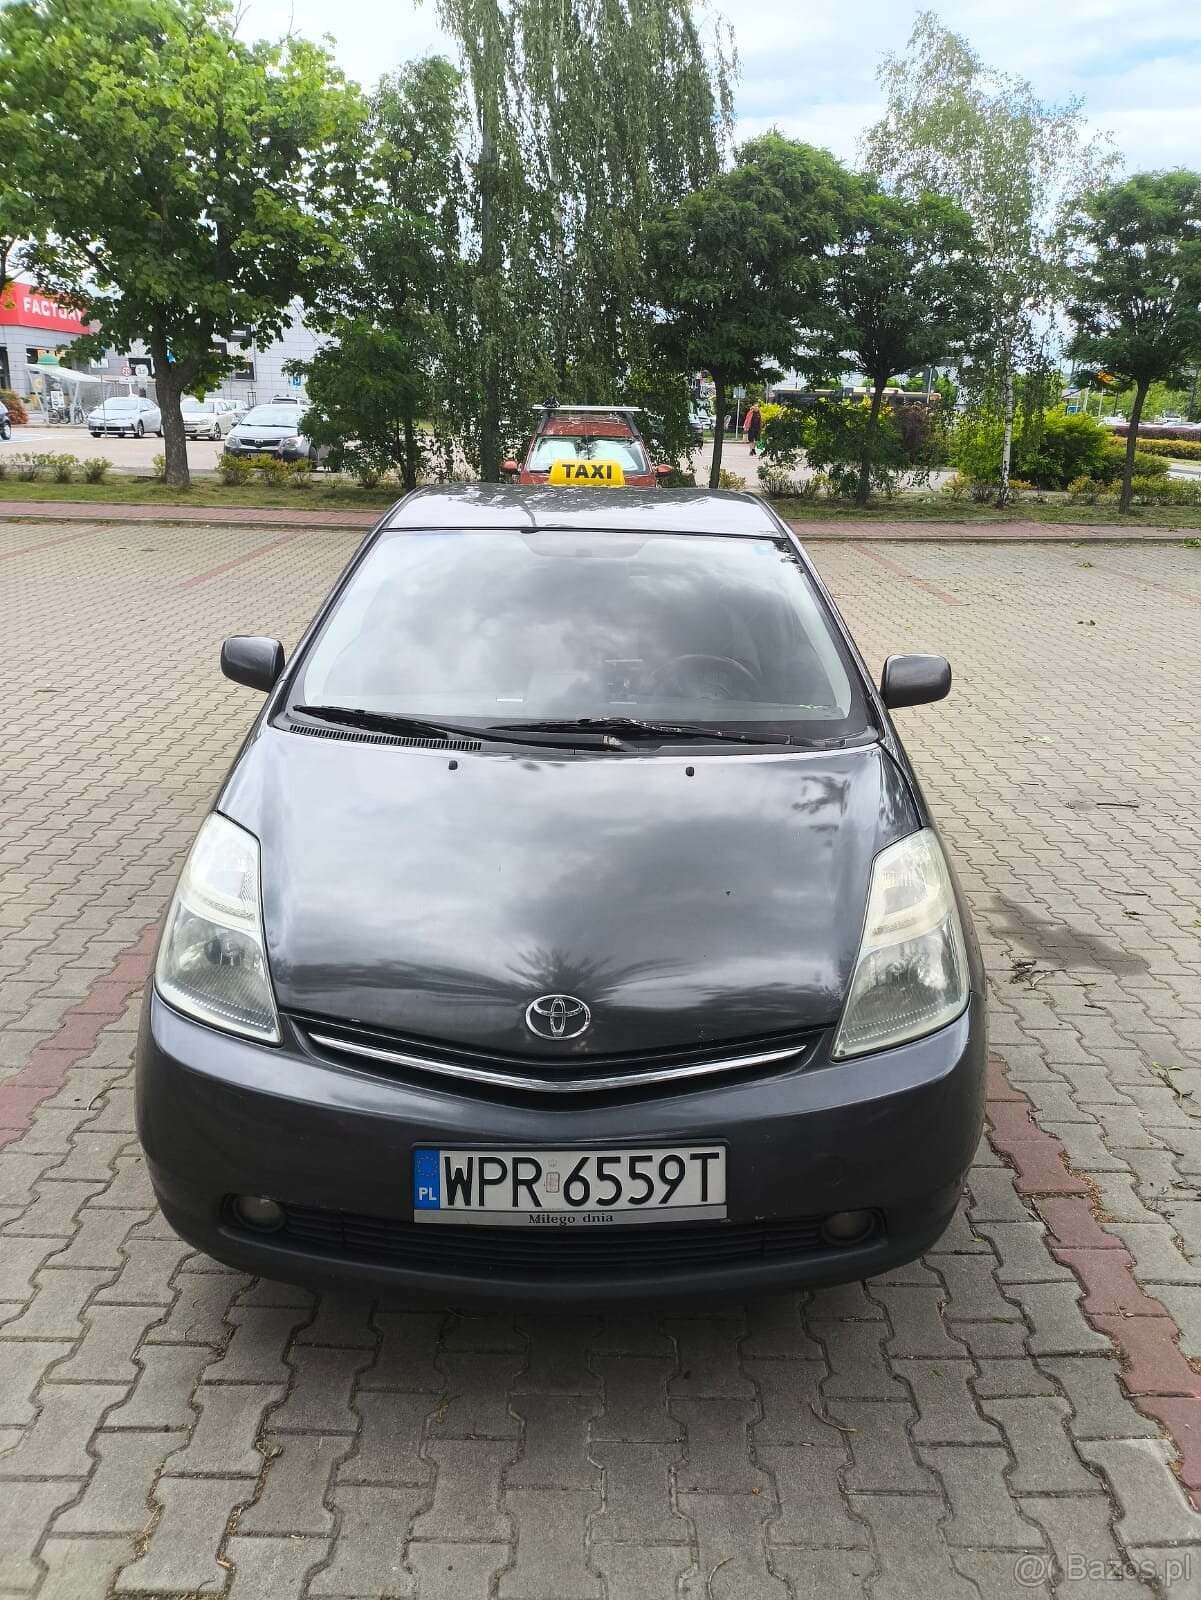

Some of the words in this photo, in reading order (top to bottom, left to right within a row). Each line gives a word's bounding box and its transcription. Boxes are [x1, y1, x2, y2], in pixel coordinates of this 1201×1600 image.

[561, 464, 612, 480] TAXI
[444, 1156, 542, 1208] WPR
[563, 1152, 720, 1207] 6559T
[418, 1186, 437, 1201] PL
[582, 1213, 614, 1223] dnia
